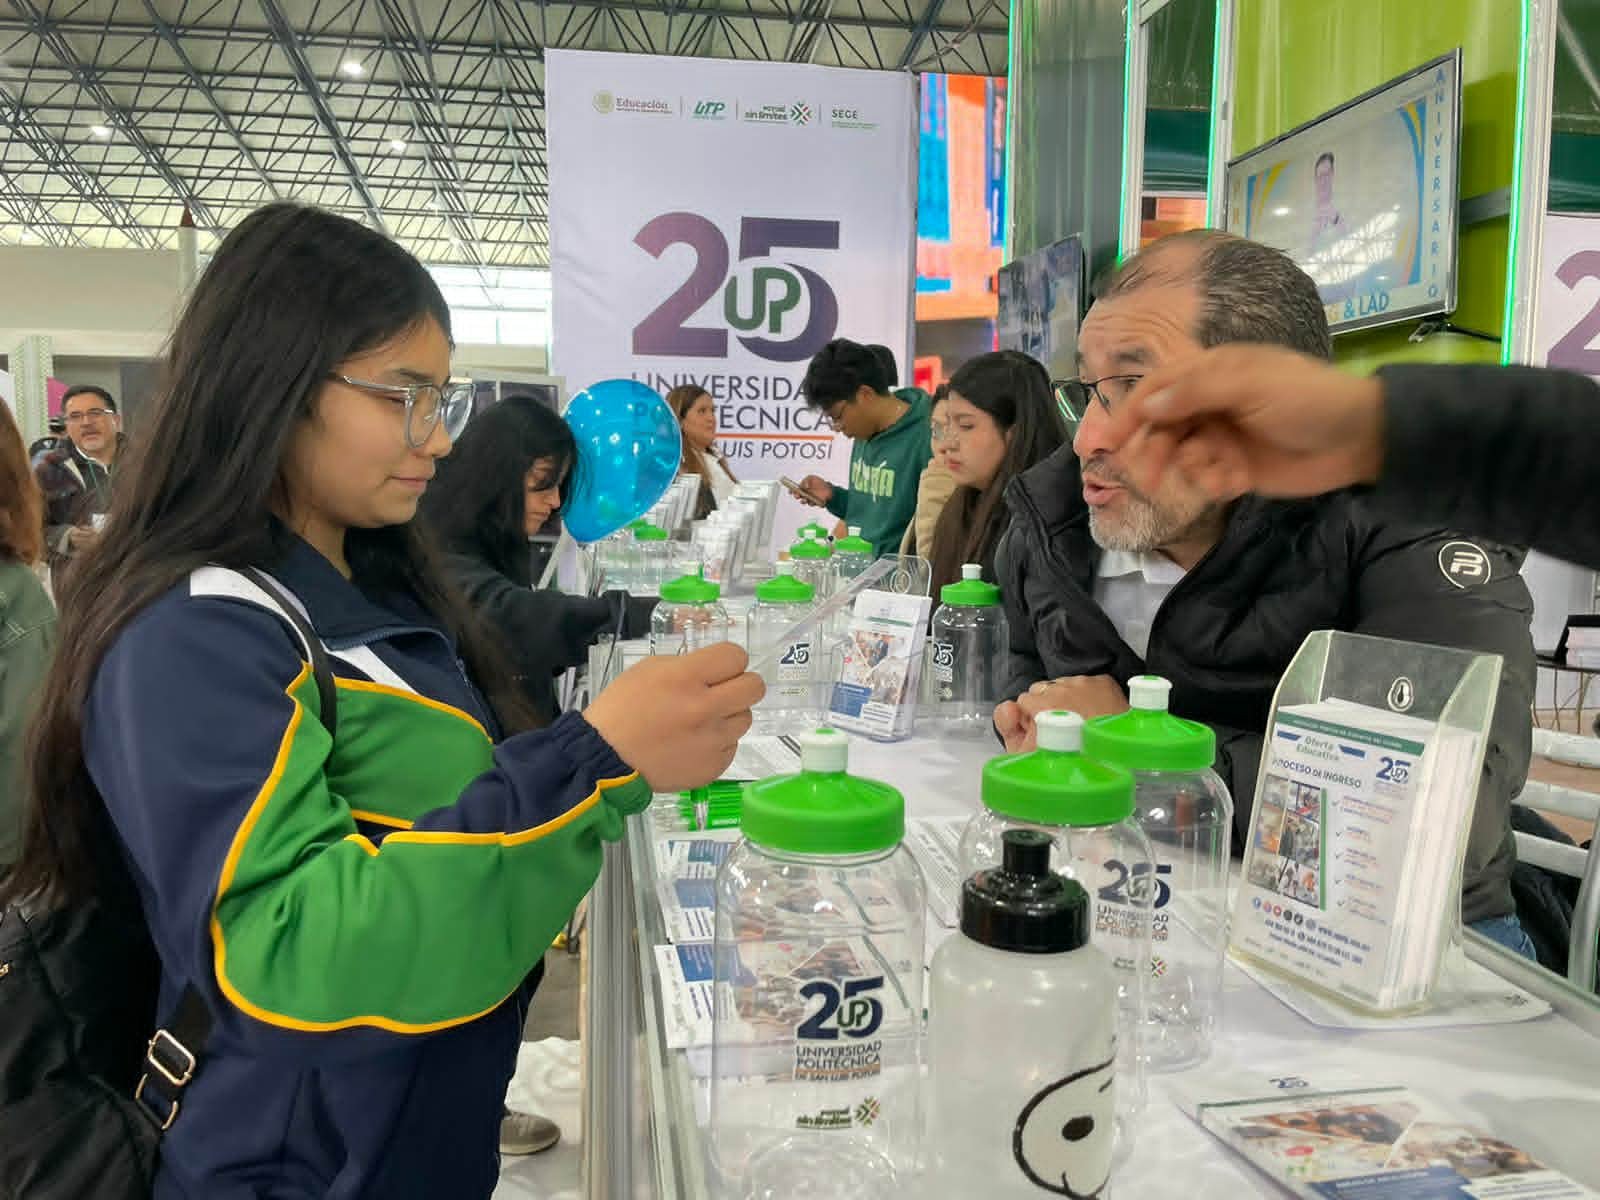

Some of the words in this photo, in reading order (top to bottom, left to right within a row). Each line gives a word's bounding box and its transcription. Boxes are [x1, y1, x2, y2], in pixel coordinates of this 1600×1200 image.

[615, 98, 669, 109] Educación
[1428, 68, 1446, 298] ANIVERSARIO
[632, 211, 841, 362] 25
[723, 266, 801, 334] UP
[1359, 288, 1389, 316] LAD
[716, 441, 754, 459] UIS
[780, 643, 810, 665] 25
[1323, 770, 1361, 789] INGRESO
[1375, 756, 1411, 785] 25
[796, 975, 884, 1041] 25
[836, 1000, 870, 1028] UP
[795, 1040, 882, 1057] UNIVERSIDAD
